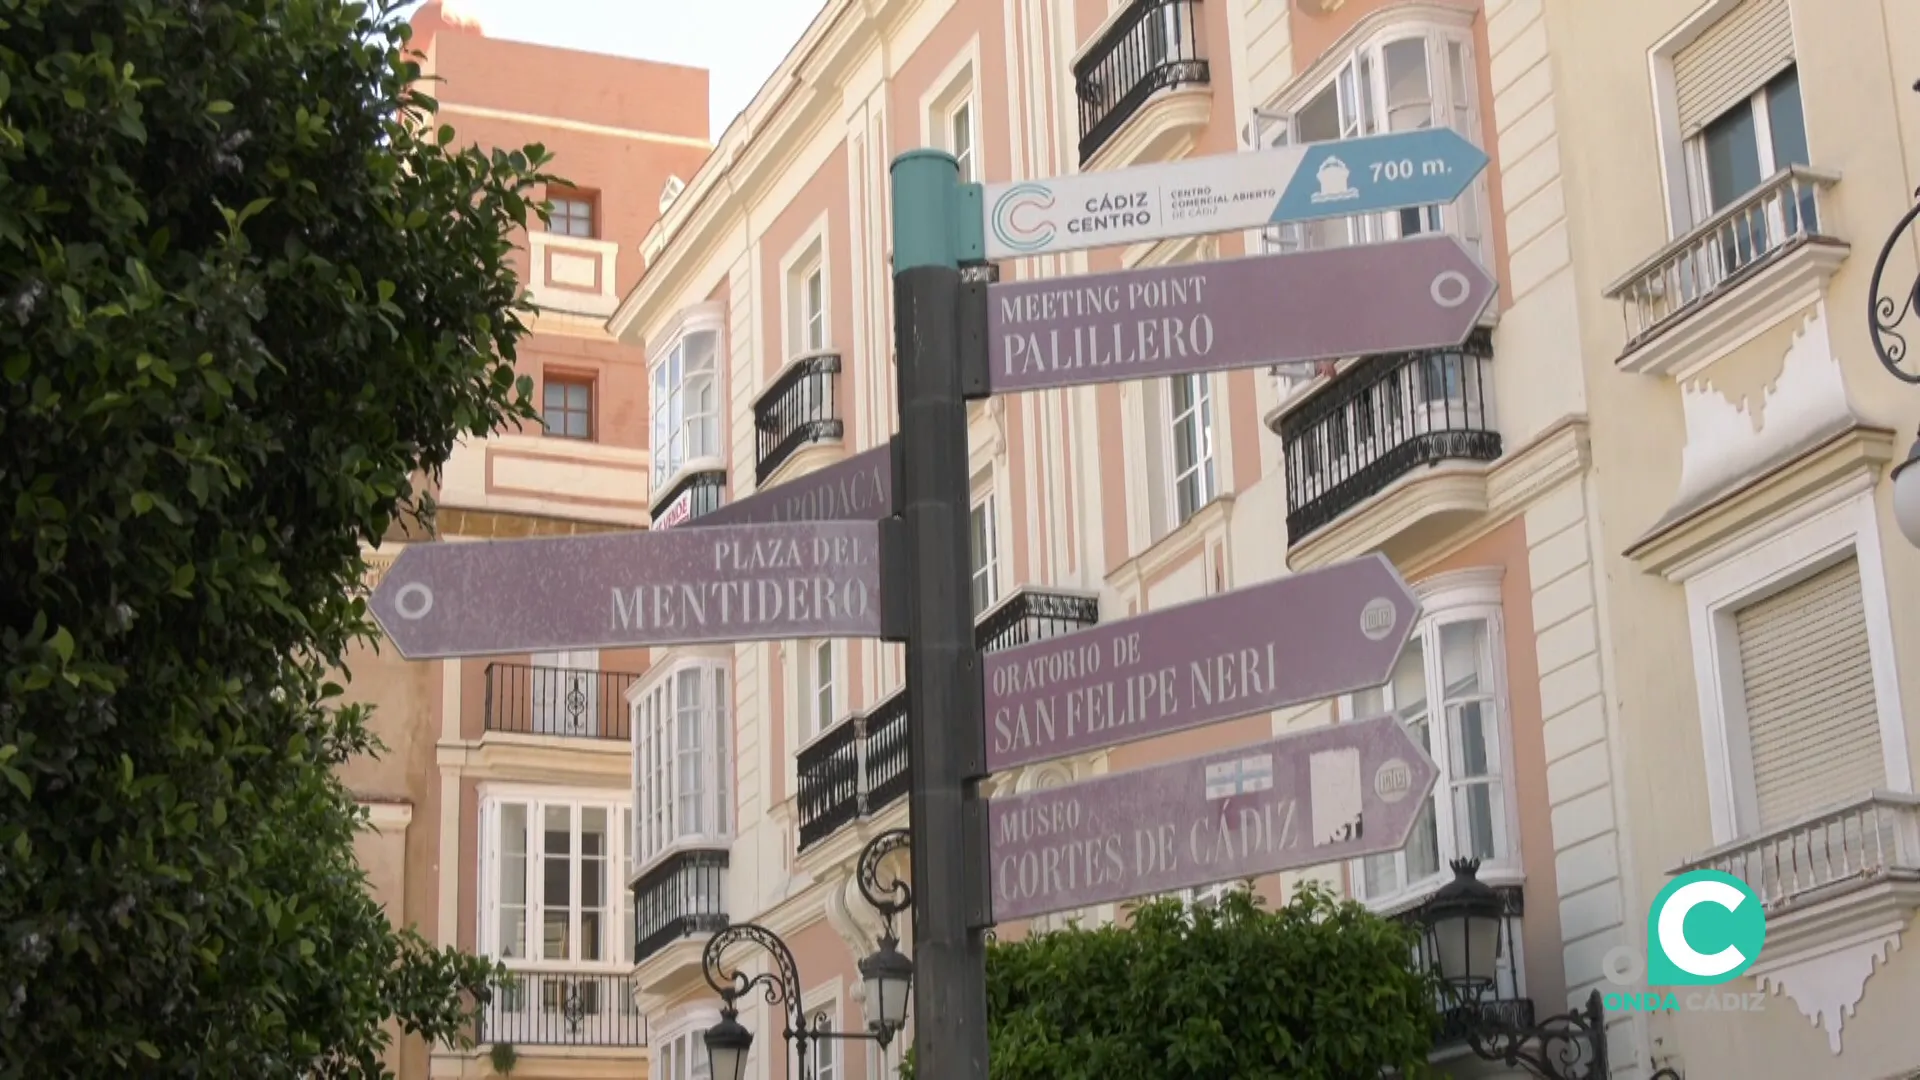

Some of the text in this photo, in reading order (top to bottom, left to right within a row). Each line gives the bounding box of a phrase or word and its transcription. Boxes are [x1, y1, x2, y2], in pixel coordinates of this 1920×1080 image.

[1170, 187, 1211, 199] CENTRO
[1368, 159, 1452, 183] 700 m.
[1085, 191, 1148, 213] CÁDIZ
[1171, 188, 1276, 209] COMERCIAL ABIERTO
[1067, 211, 1151, 233] CENTRO
[1000, 275, 1207, 324] MEETING POINT
[1003, 313, 1214, 377] PALILLERO
[714, 536, 869, 571] PLAZA DEL
[610, 577, 869, 631] MENTIDERO
[993, 632, 1141, 697] ORATORIO DE
[995, 641, 1277, 753] SAN FELIPE NERI
[1000, 800, 1081, 844] MUSEO
[1001, 834, 1124, 900] CORTES
[1134, 824, 1178, 877] DE
[1190, 798, 1299, 864] CÁDIZ
